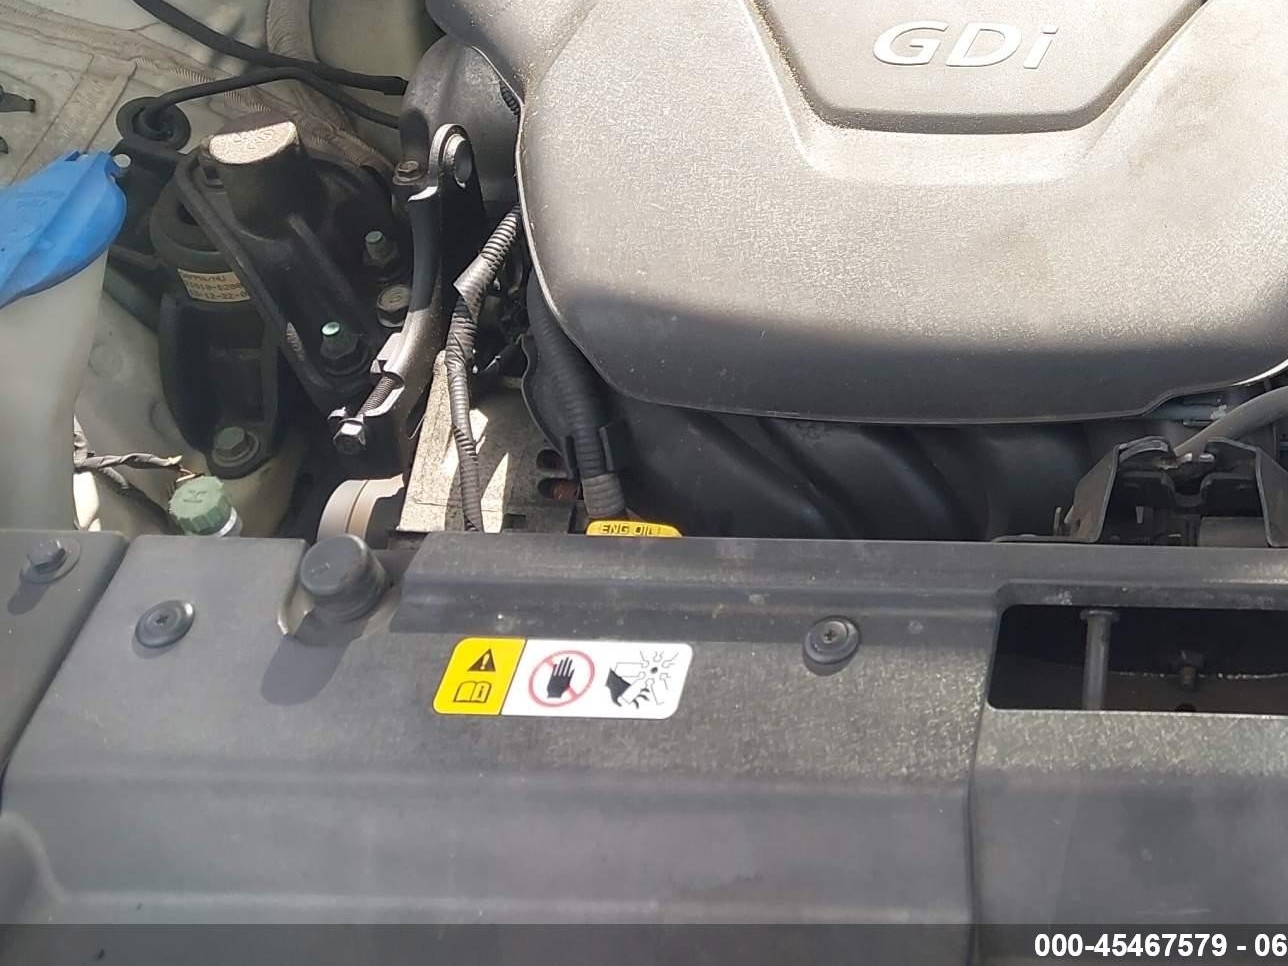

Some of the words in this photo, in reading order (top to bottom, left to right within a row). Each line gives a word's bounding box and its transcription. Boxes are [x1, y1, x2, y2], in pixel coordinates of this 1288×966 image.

[872, 20, 1059, 69] GDi
[602, 523, 629, 534] ENG
[634, 525, 652, 535] OIL
